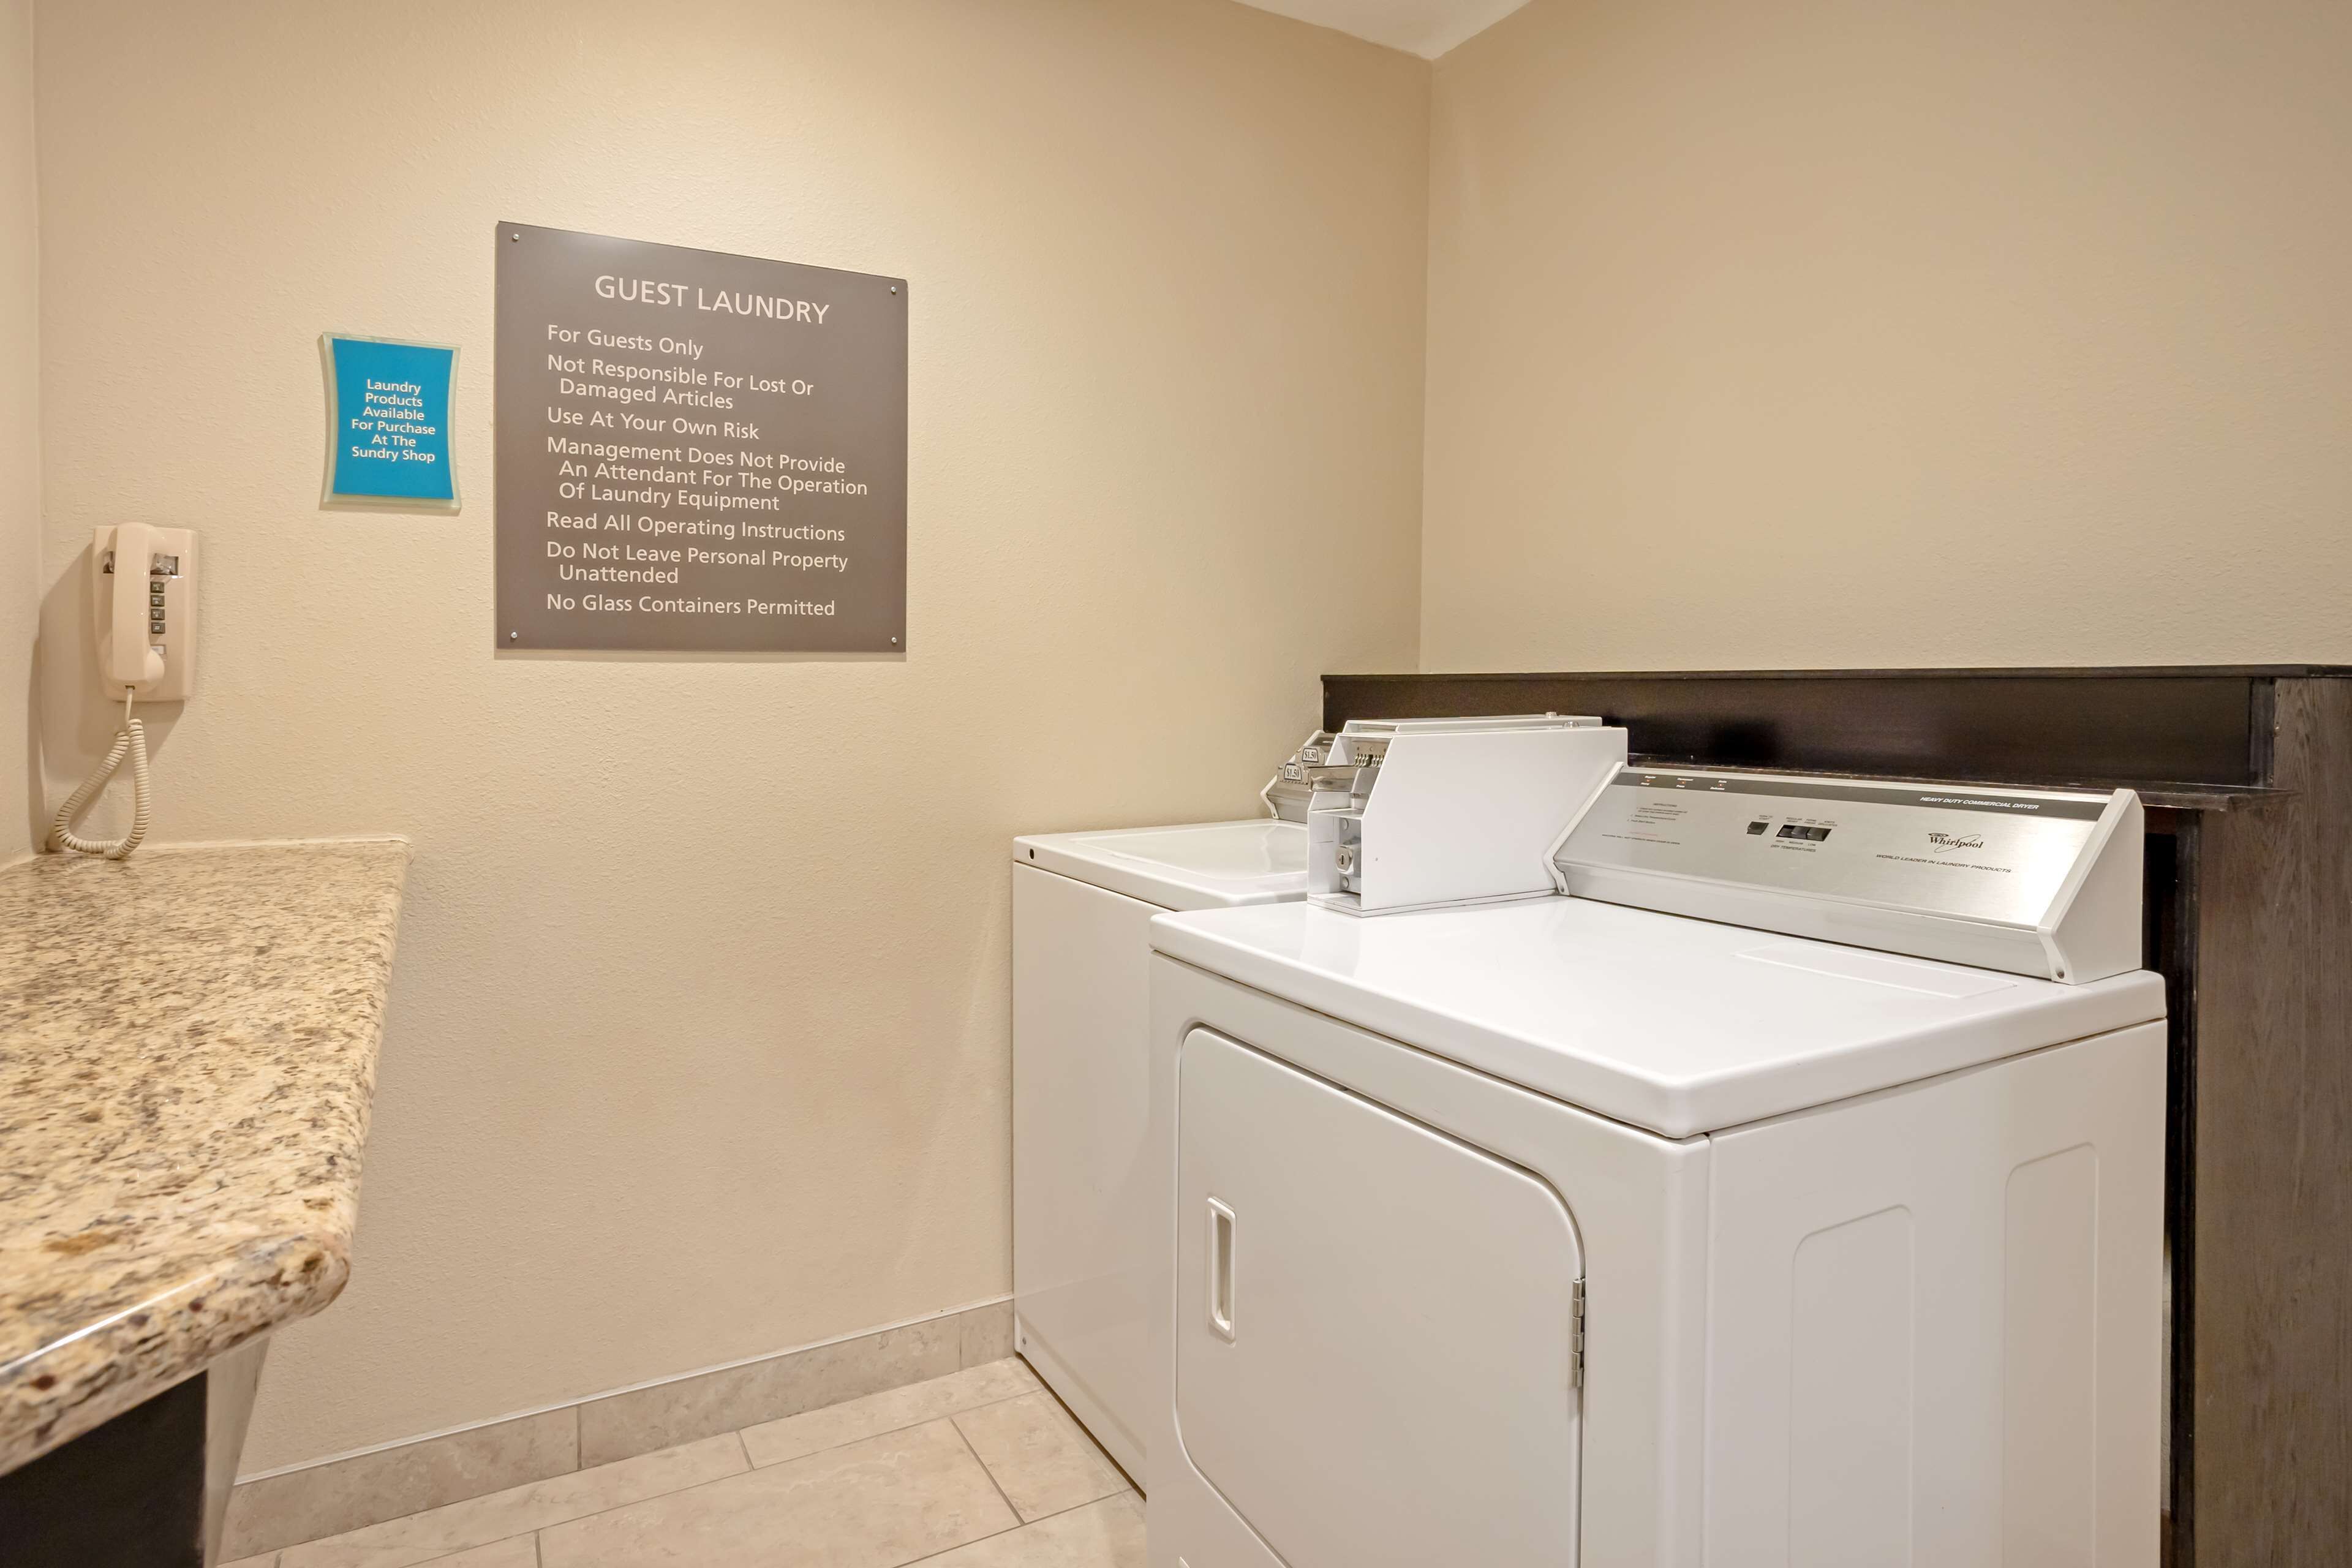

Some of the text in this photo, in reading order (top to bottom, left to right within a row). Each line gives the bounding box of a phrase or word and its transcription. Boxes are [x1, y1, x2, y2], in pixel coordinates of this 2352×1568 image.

[595, 276, 829, 323] GUEST LAUNDRY
[549, 325, 703, 360] For Guests Only
[549, 355, 813, 395] Not Responsible For Lost Or
[367, 379, 421, 395] Laundry
[561, 378, 733, 409] Damaged Articles
[365, 393, 422, 407] Products
[363, 407, 424, 420] Available
[352, 419, 435, 434] For Purchase
[548, 407, 759, 439] Use At Your Own Risk
[372, 434, 416, 447] At The
[352, 447, 435, 463] Sundry Shop
[548, 437, 845, 473] Management Does Not Provide
[559, 461, 867, 495] An Attendant For The Operation
[559, 483, 779, 511] Of Laundry Equipment
[548, 511, 845, 541] Read All Operating Instructions
[548, 541, 848, 572] Do Not Leave Personal Property
[560, 565, 677, 583] Unattended
[548, 594, 834, 616] No Glass Containers Permitted
[1304, 750, 1317, 759] $1.50
[1286, 768, 1299, 778] $1.50
[1962, 799, 2011, 808] COMMERCIAL
[1930, 836, 1984, 849] Whirlpool
[1972, 865, 2011, 873] PRODUCTS
